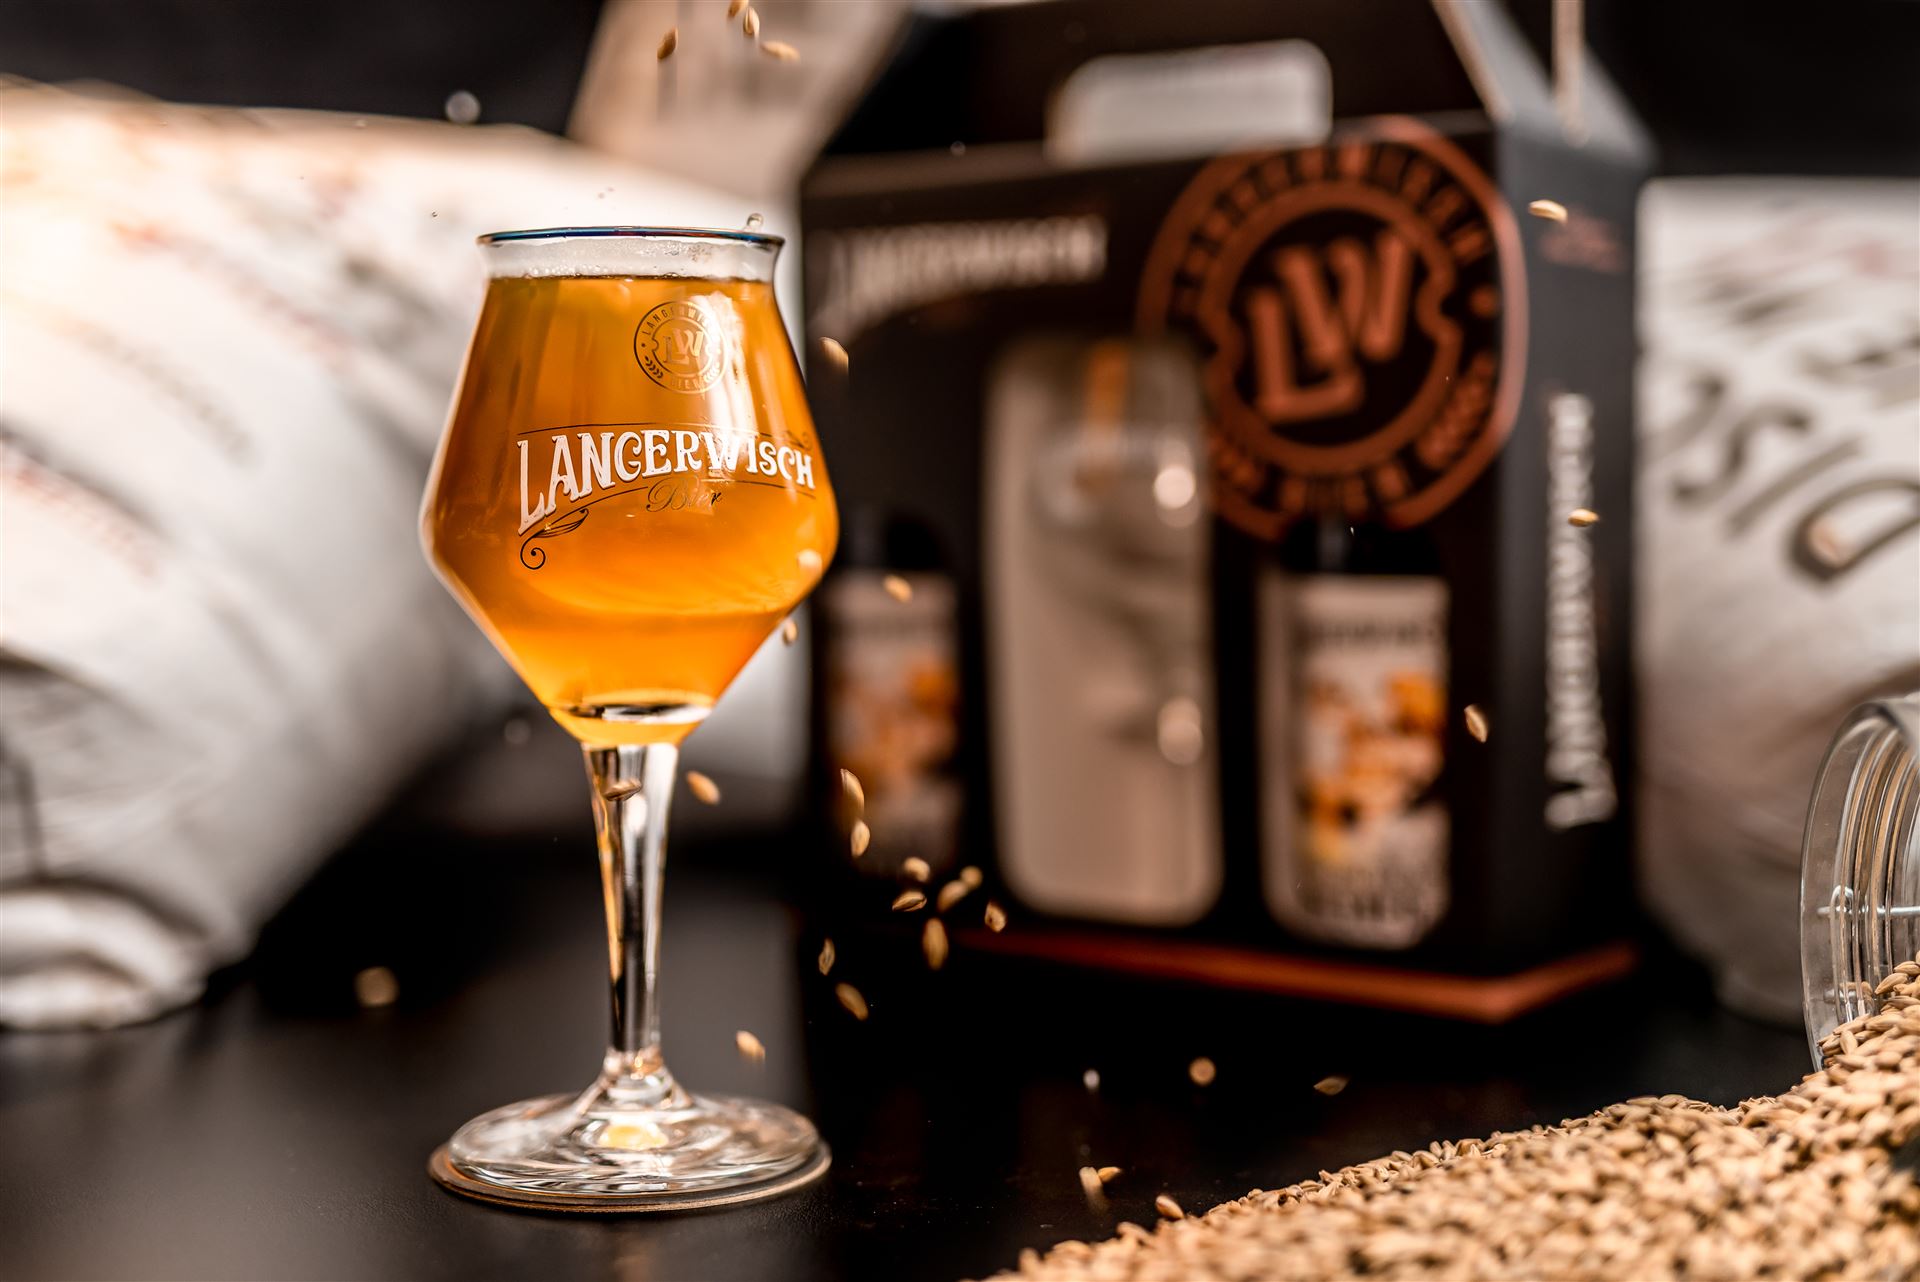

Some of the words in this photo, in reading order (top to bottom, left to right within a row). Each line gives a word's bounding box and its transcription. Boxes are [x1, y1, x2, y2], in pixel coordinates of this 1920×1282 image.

[663, 328, 704, 364] LW
[1250, 232, 1413, 423] LW
[517, 428, 816, 535] LANGERWISCH
